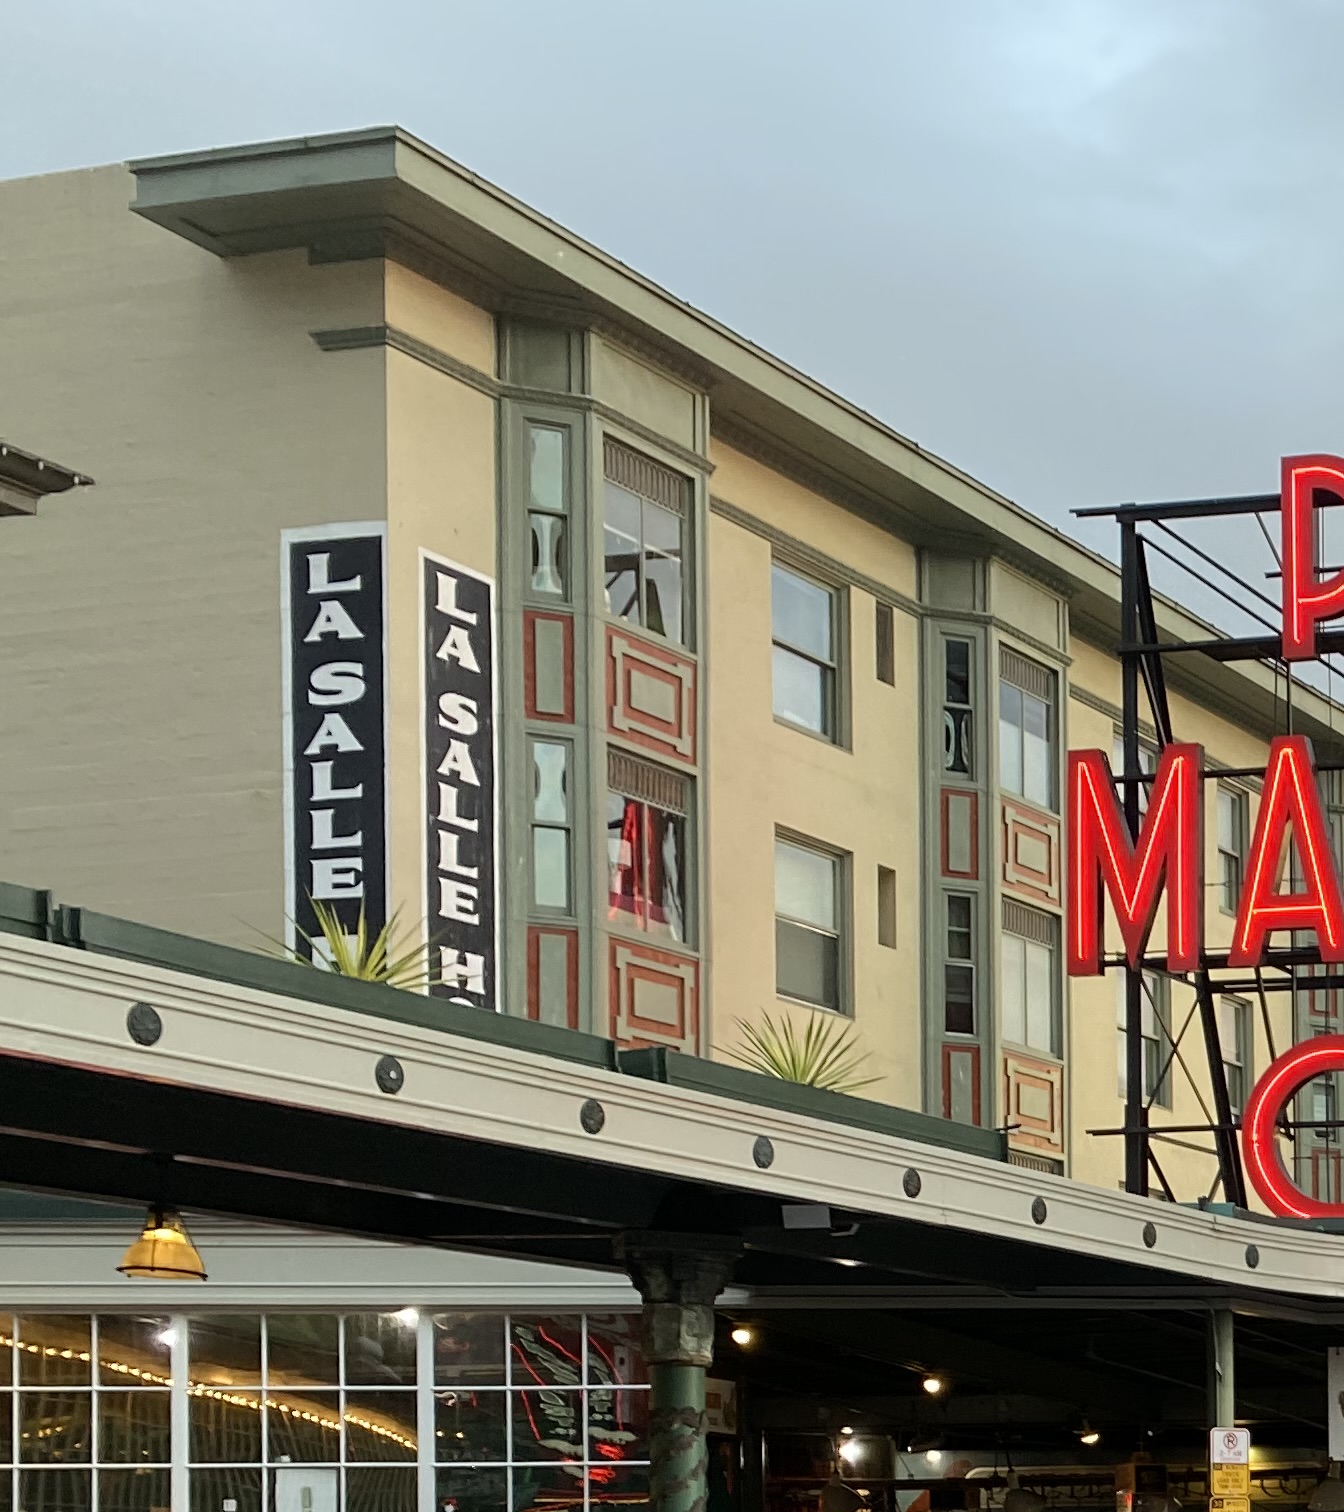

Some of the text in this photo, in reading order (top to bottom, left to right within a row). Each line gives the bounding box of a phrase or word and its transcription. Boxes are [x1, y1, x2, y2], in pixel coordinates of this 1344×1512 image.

[303, 552, 365, 643] LA
[303, 661, 366, 900] SALLE
[434, 571, 486, 1008] LA SALLE H
